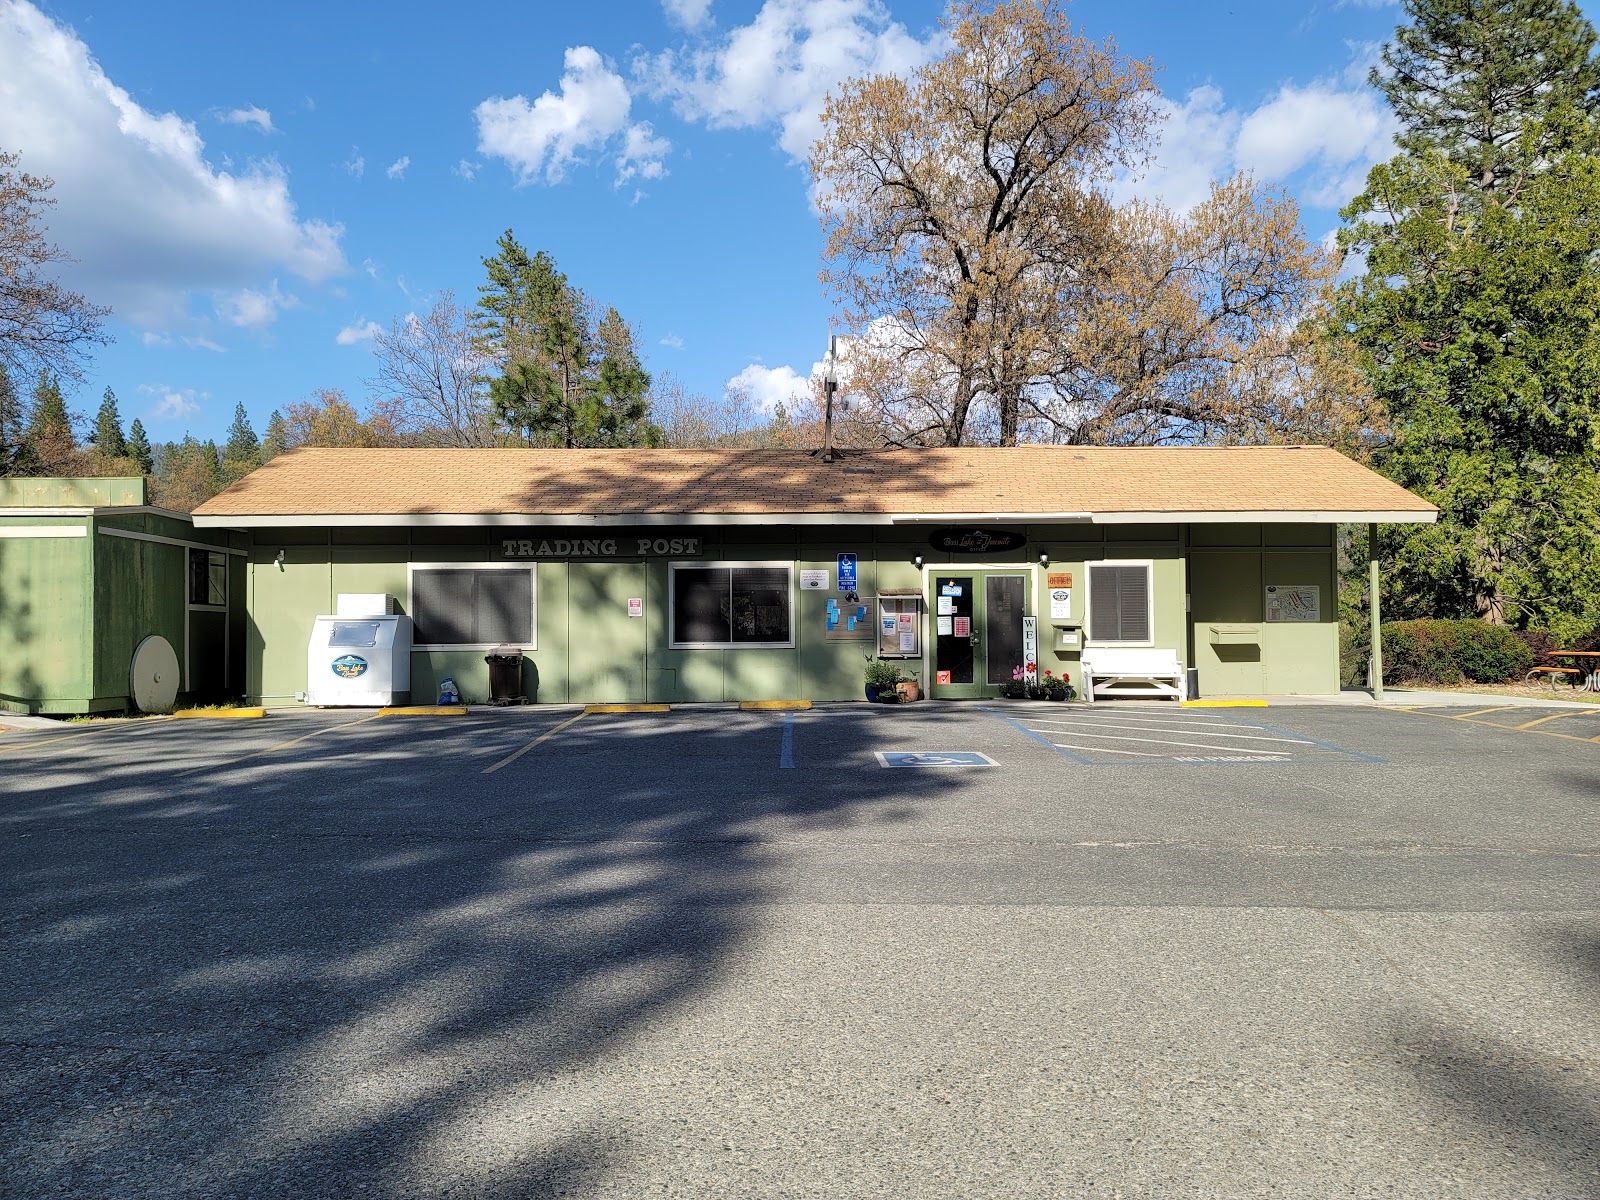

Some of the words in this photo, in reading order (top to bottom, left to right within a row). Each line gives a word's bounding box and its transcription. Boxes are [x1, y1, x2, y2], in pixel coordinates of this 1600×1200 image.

[943, 537, 959, 546] Bass
[959, 536, 974, 547] Lake
[502, 540, 617, 556] TRADING
[637, 539, 698, 555] POST
[1050, 577, 1071, 585] OFFICE
